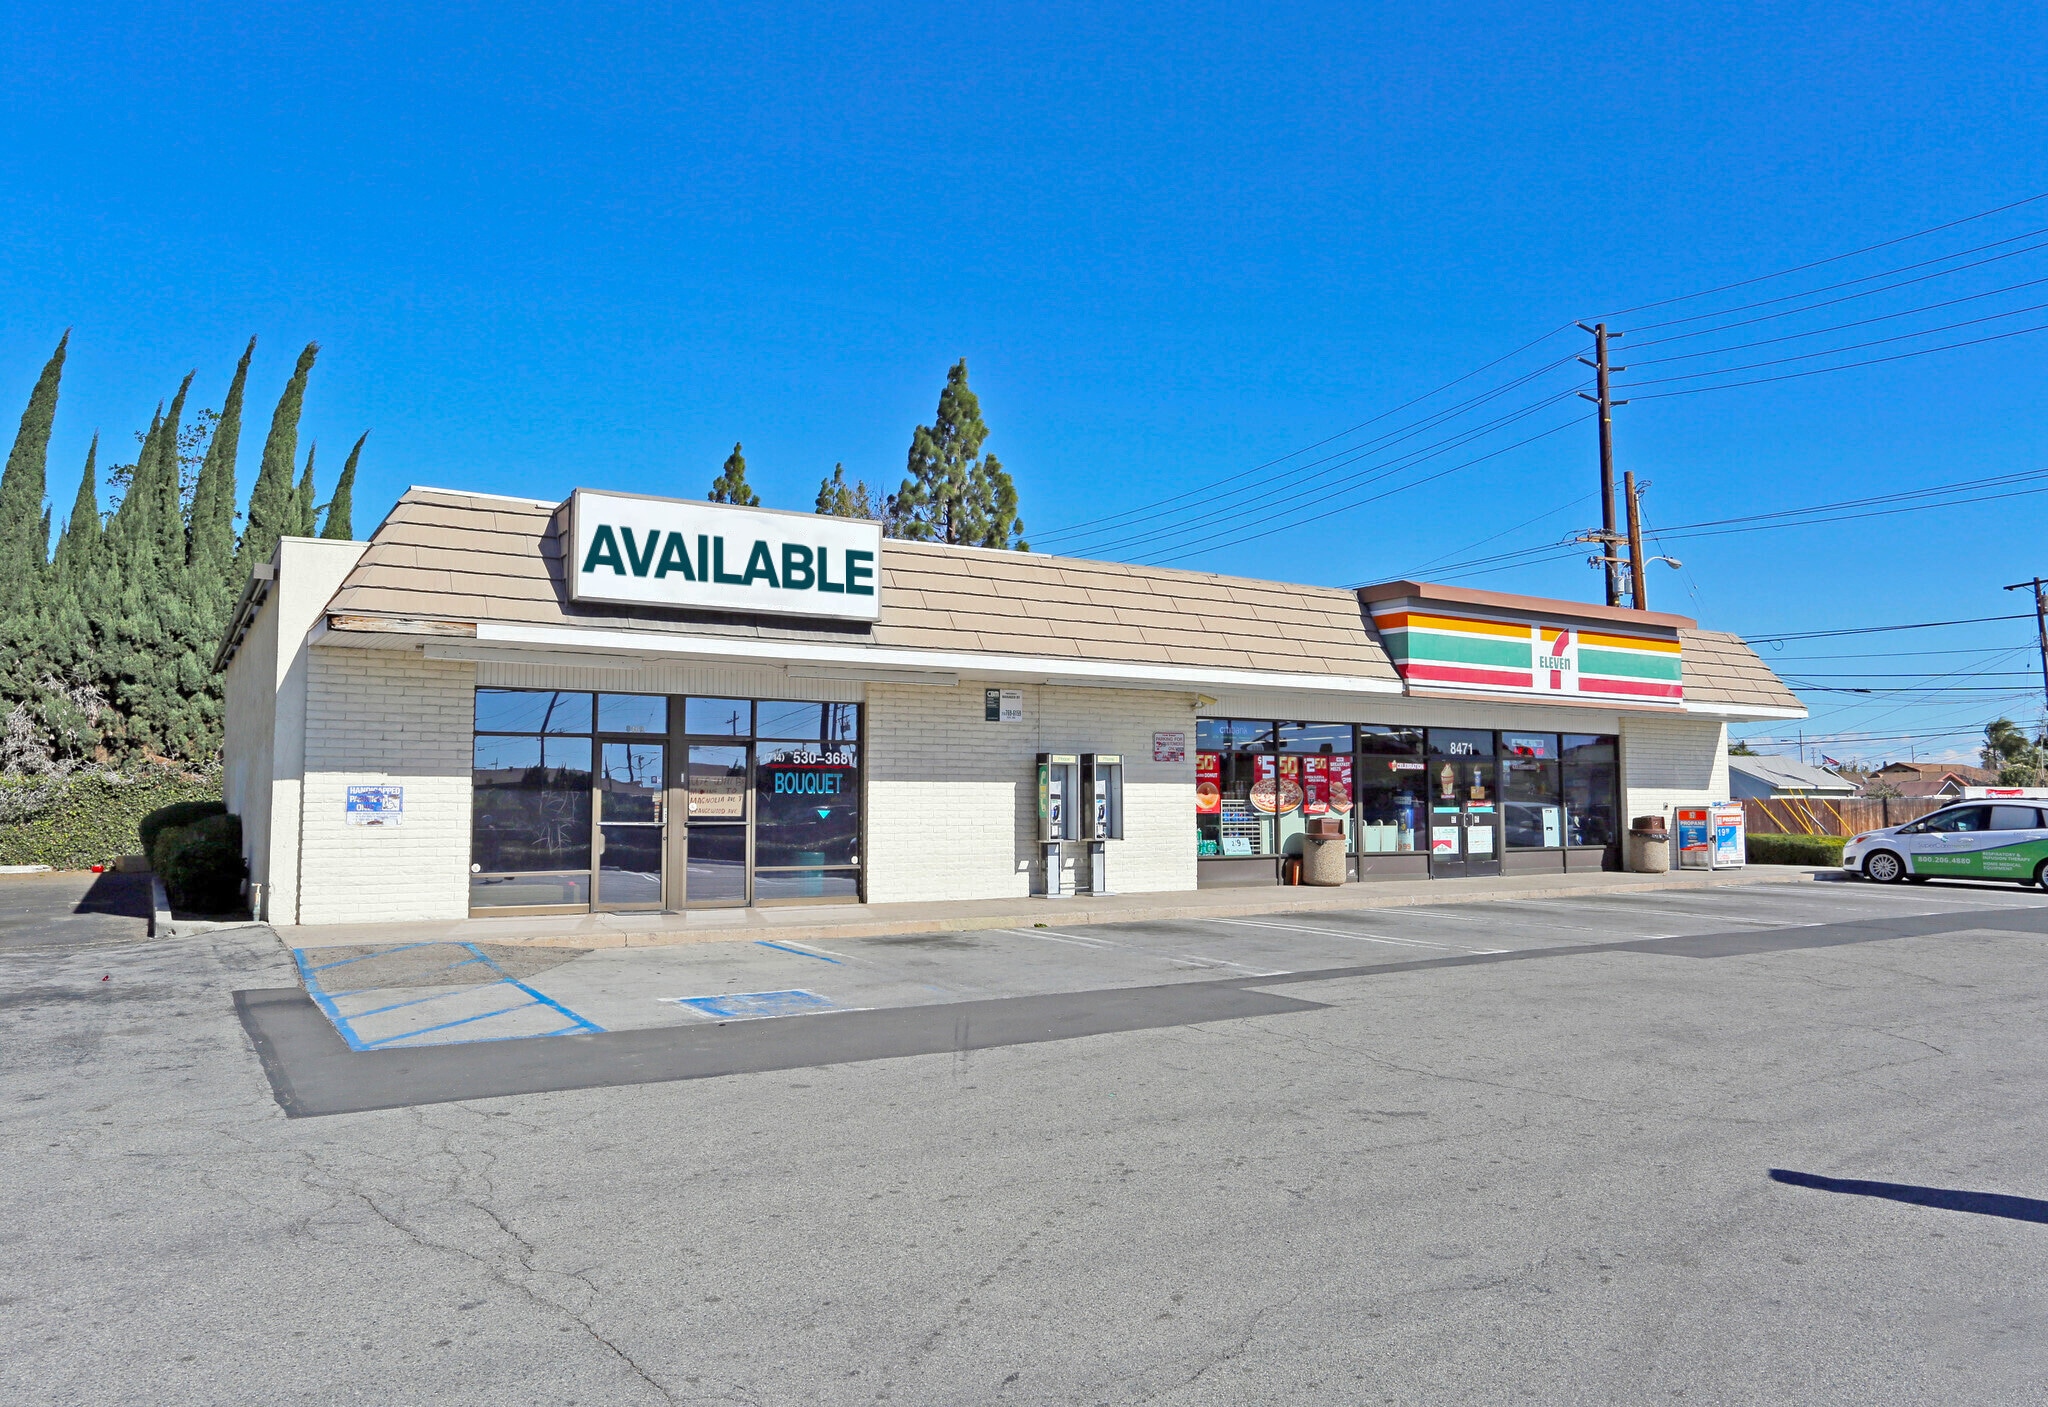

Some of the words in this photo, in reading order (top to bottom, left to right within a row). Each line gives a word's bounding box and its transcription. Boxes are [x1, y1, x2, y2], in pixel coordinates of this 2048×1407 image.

[582, 524, 874, 596] AVAILABLE
[1550, 628, 1569, 690] 7
[1450, 742, 1473, 755] 8471
[793, 751, 854, 765] 530-3681
[775, 772, 843, 794] BOUQUET
[1918, 856, 1971, 864] 800.206.4880
